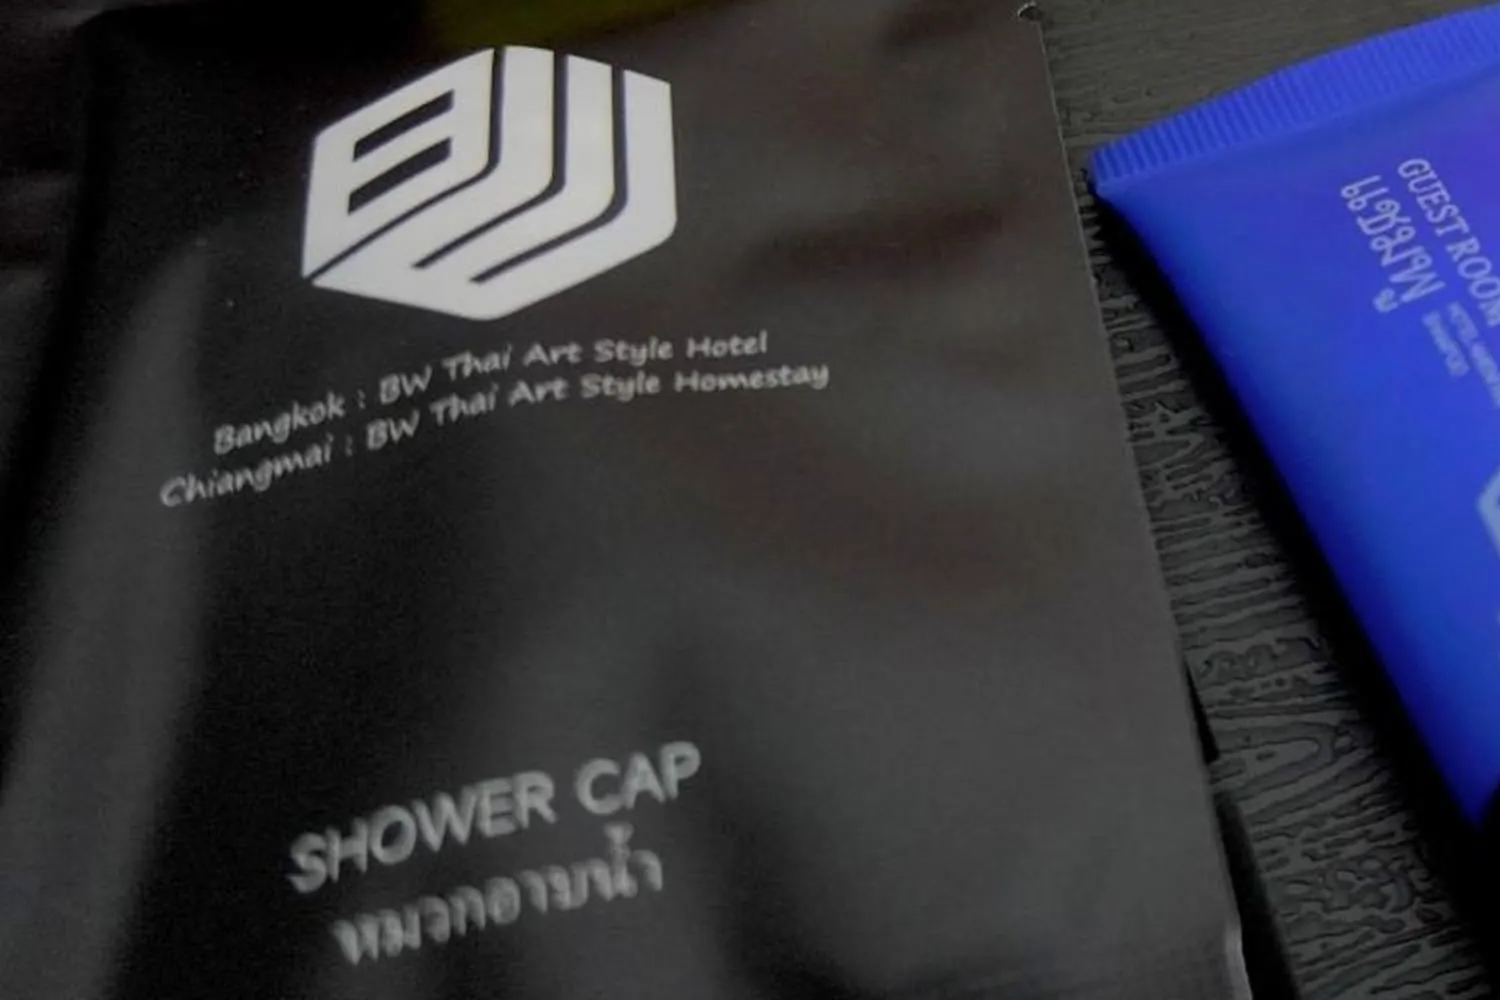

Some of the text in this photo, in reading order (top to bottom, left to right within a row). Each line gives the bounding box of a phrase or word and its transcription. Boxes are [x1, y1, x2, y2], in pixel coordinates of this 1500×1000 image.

[1340, 174, 1446, 313] แชมพู
[1397, 157, 1470, 237] GUEST
[159, 431, 335, 507] Chiangmai
[367, 409, 420, 449] BW
[429, 382, 499, 425] Thai
[509, 376, 569, 406] Art
[579, 369, 661, 403] Style
[673, 363, 829, 391] Homestay
[213, 390, 346, 455] Bangkok
[380, 363, 432, 404] BW
[441, 343, 512, 381] Thai
[522, 342, 583, 367] Art
[594, 336, 673, 367] Style
[686, 329, 768, 358] Hotel
[288, 740, 702, 894] SHOWER CAP
